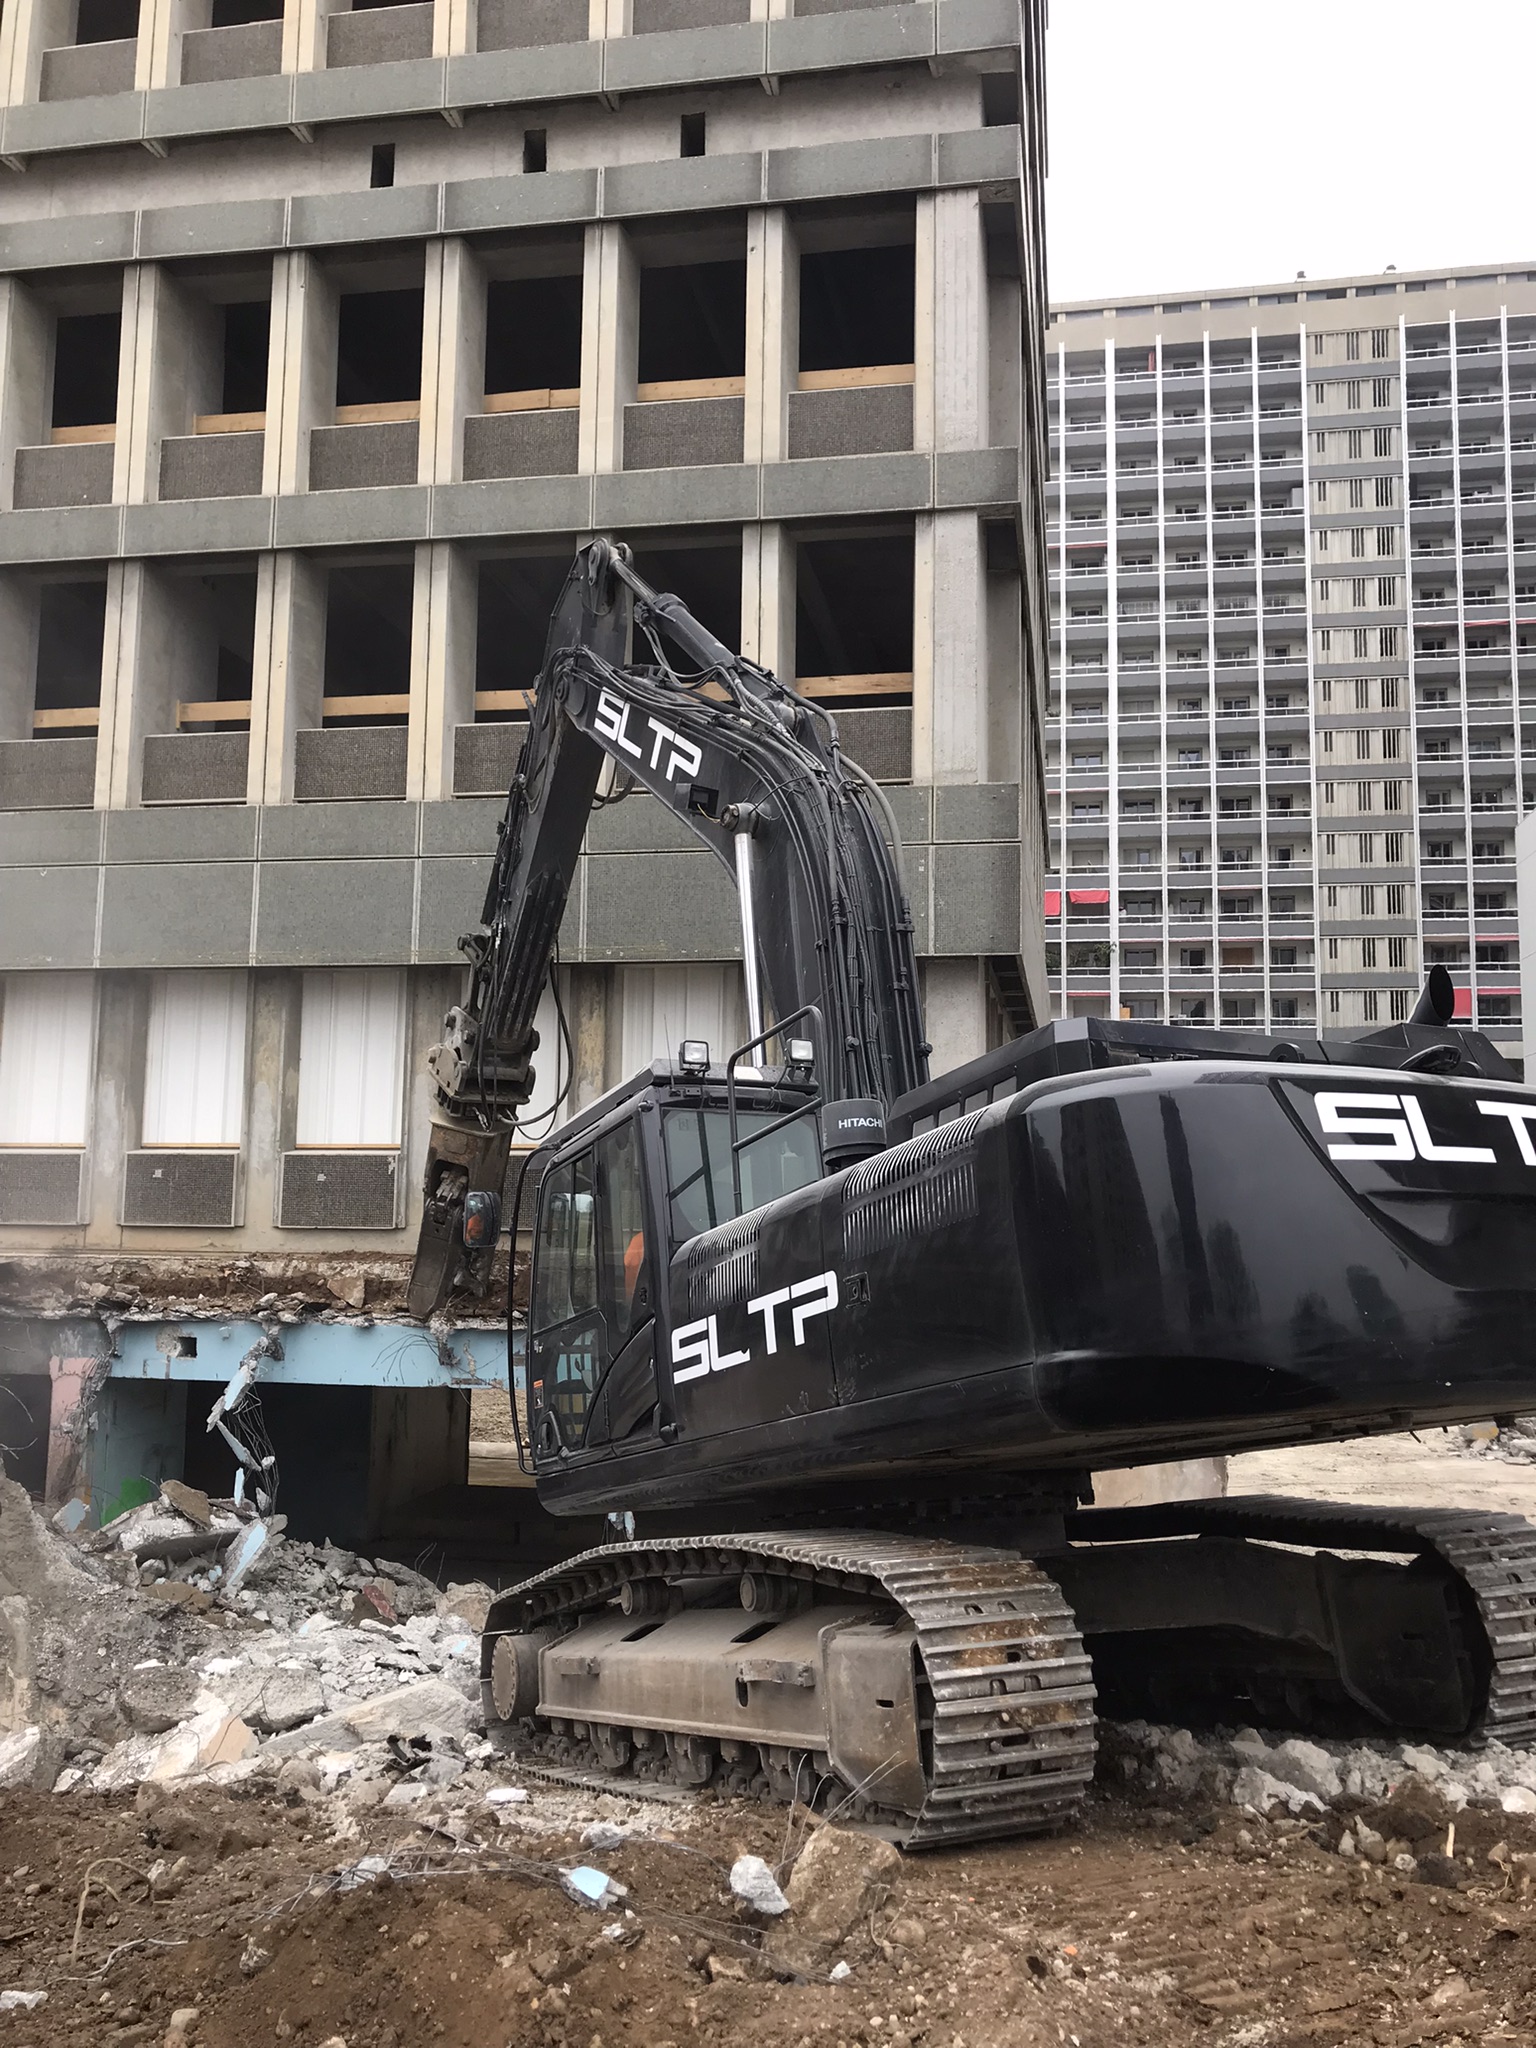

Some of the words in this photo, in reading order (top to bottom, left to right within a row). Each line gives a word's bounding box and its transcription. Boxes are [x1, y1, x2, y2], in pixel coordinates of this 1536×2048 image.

[594, 687, 702, 781] SLTP
[838, 1117, 883, 1129] HITACHI
[671, 1270, 839, 1385] SLTP
